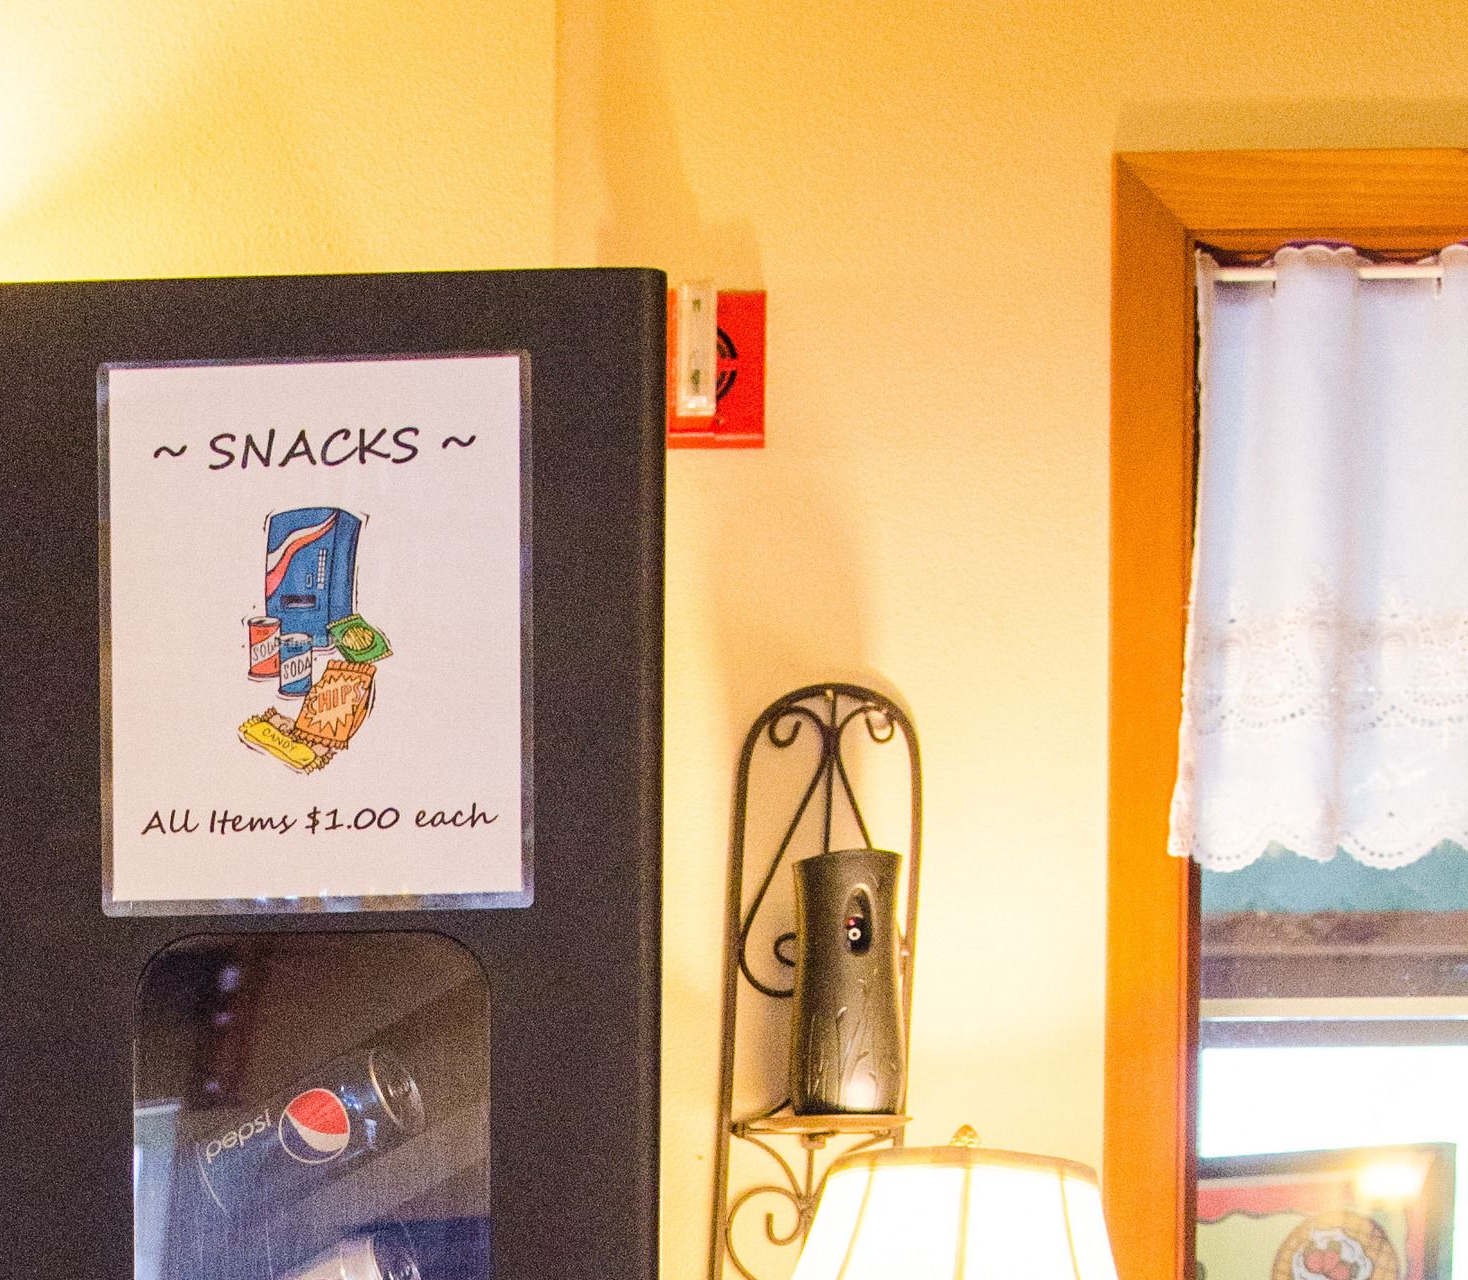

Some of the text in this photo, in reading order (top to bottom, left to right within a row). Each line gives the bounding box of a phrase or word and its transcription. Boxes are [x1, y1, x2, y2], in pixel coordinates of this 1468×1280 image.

[208, 426, 421, 471] SNACKS
[283, 658, 312, 680] SODA
[306, 684, 361, 715] CHIPS
[262, 728, 298, 752] CANDY
[141, 803, 499, 835] All Items $1.00 each
[205, 1109, 274, 1163] pepsi
